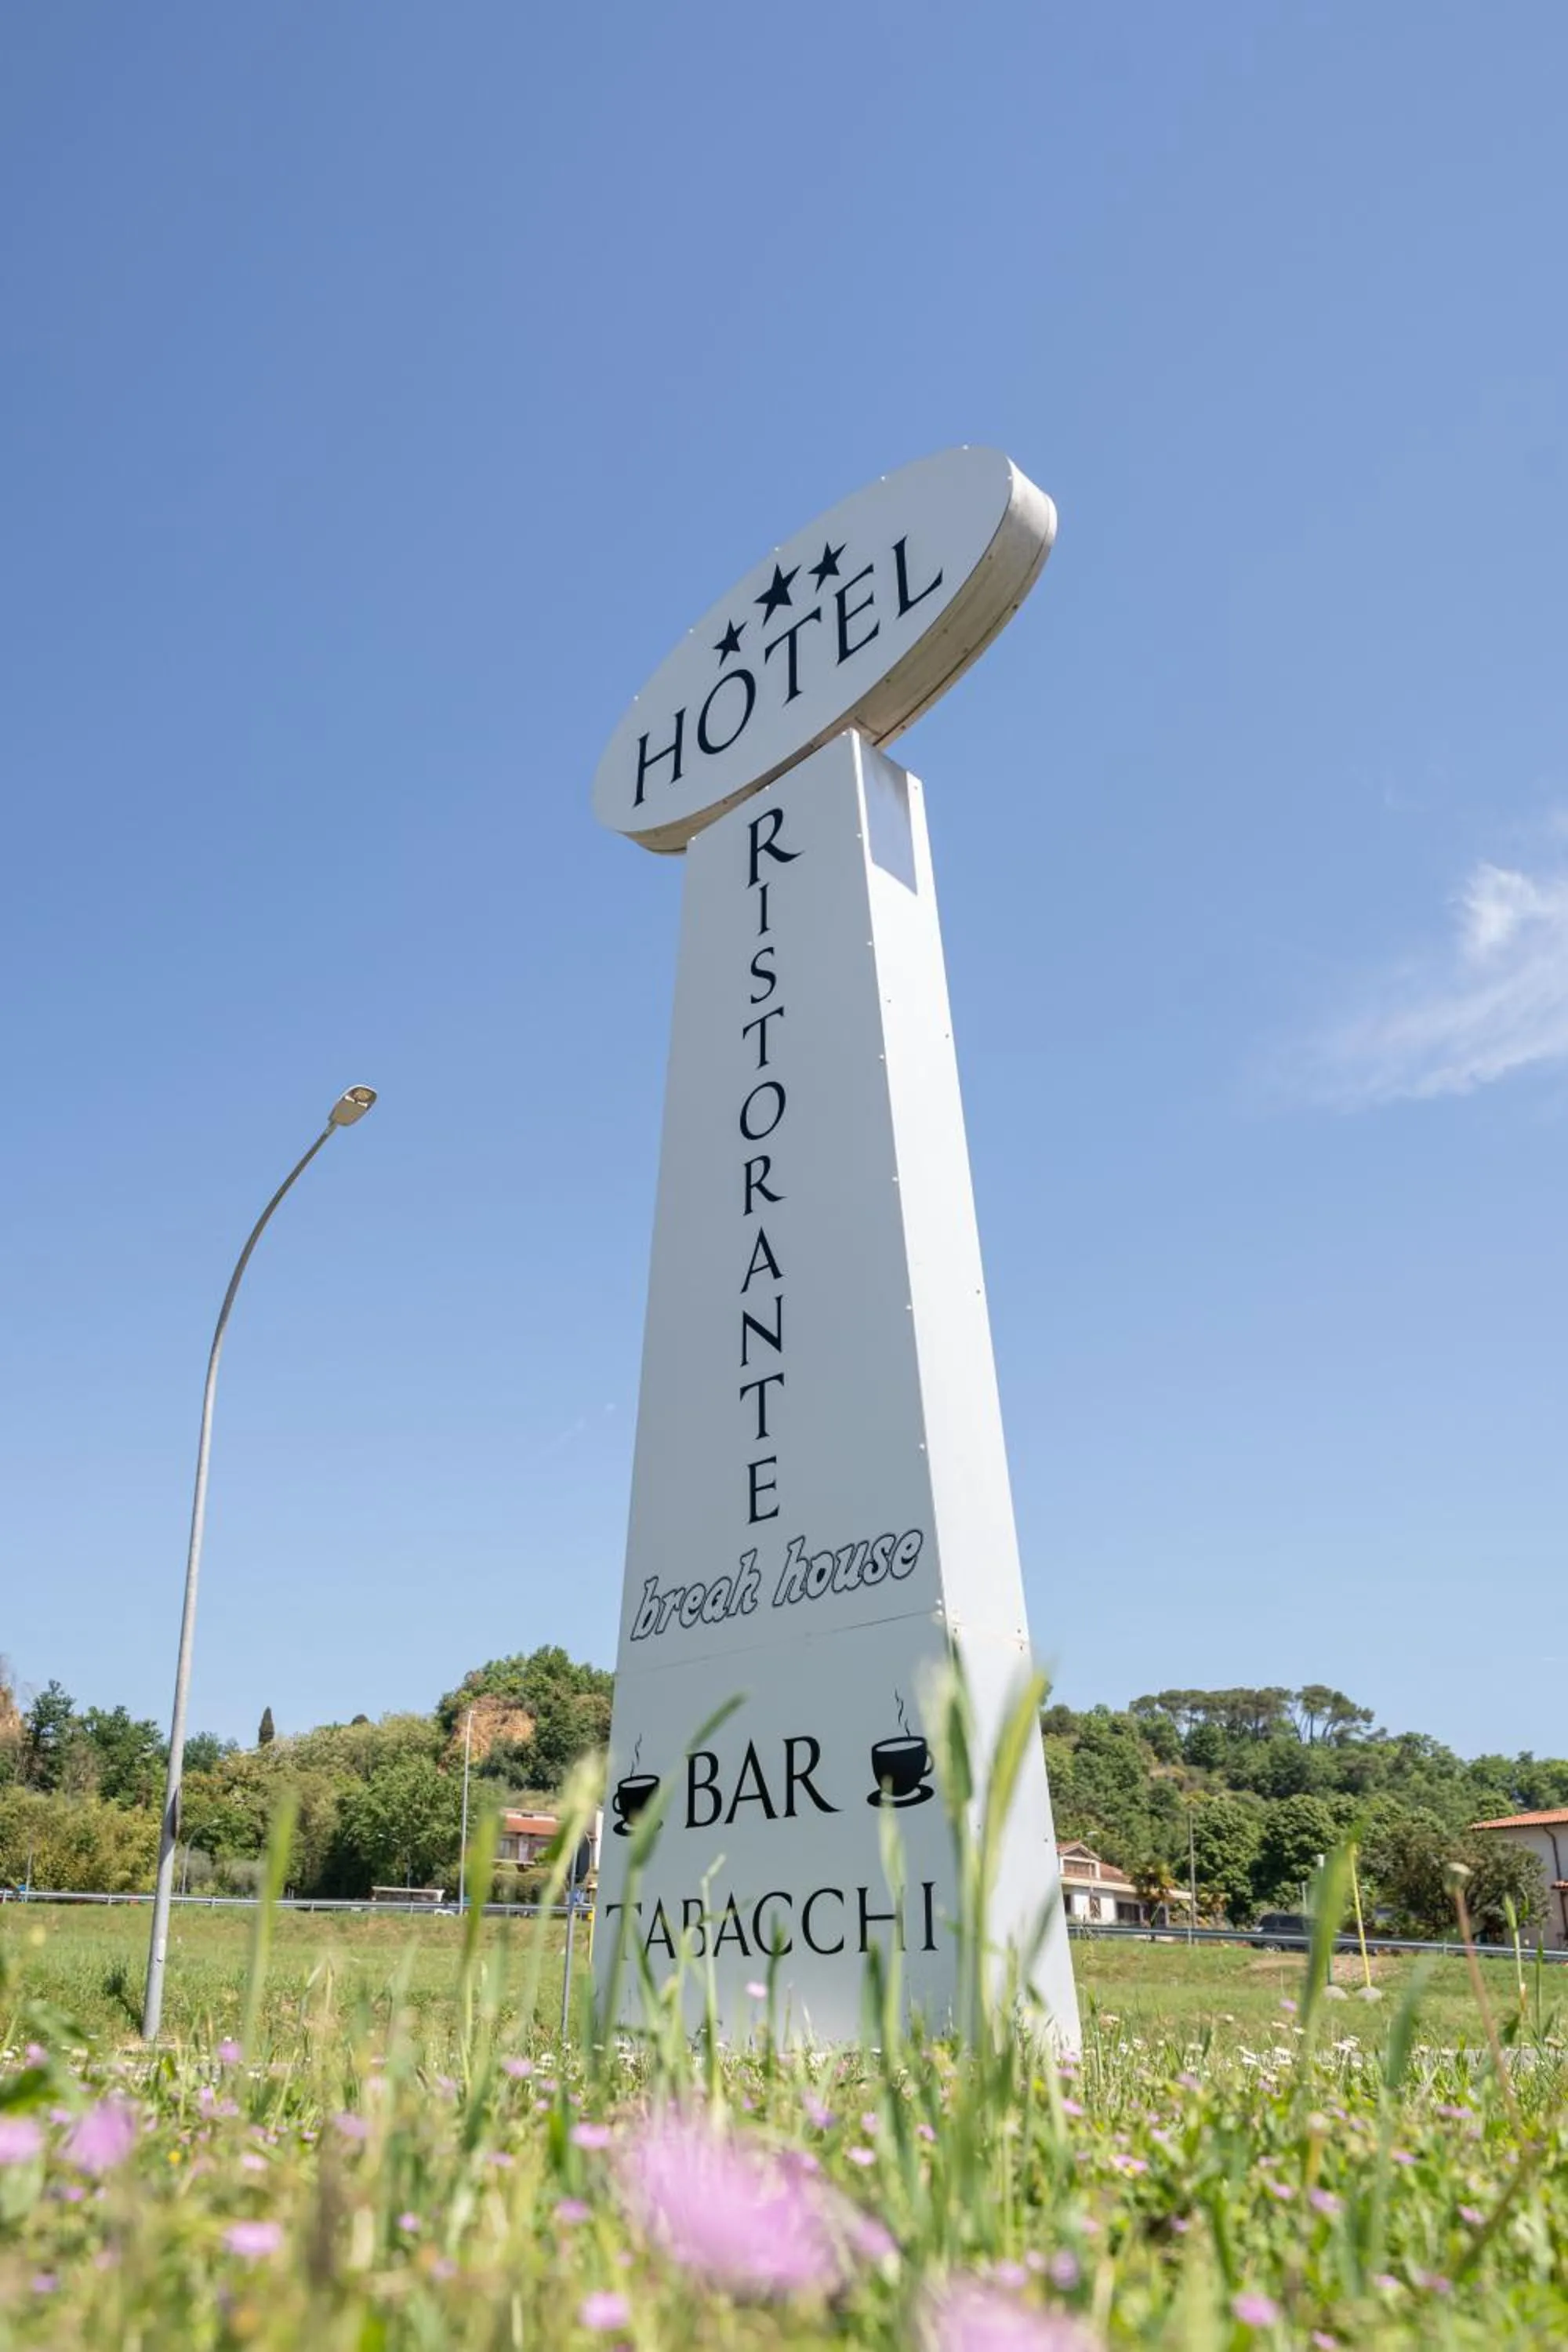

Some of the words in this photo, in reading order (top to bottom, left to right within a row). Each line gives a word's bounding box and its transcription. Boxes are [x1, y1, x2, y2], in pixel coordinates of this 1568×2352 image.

[633, 535, 942, 808] HOTEL
[739, 808, 804, 1524] RISTORANTE
[772, 1530, 924, 1607] house
[685, 1736, 842, 1829] BAR
